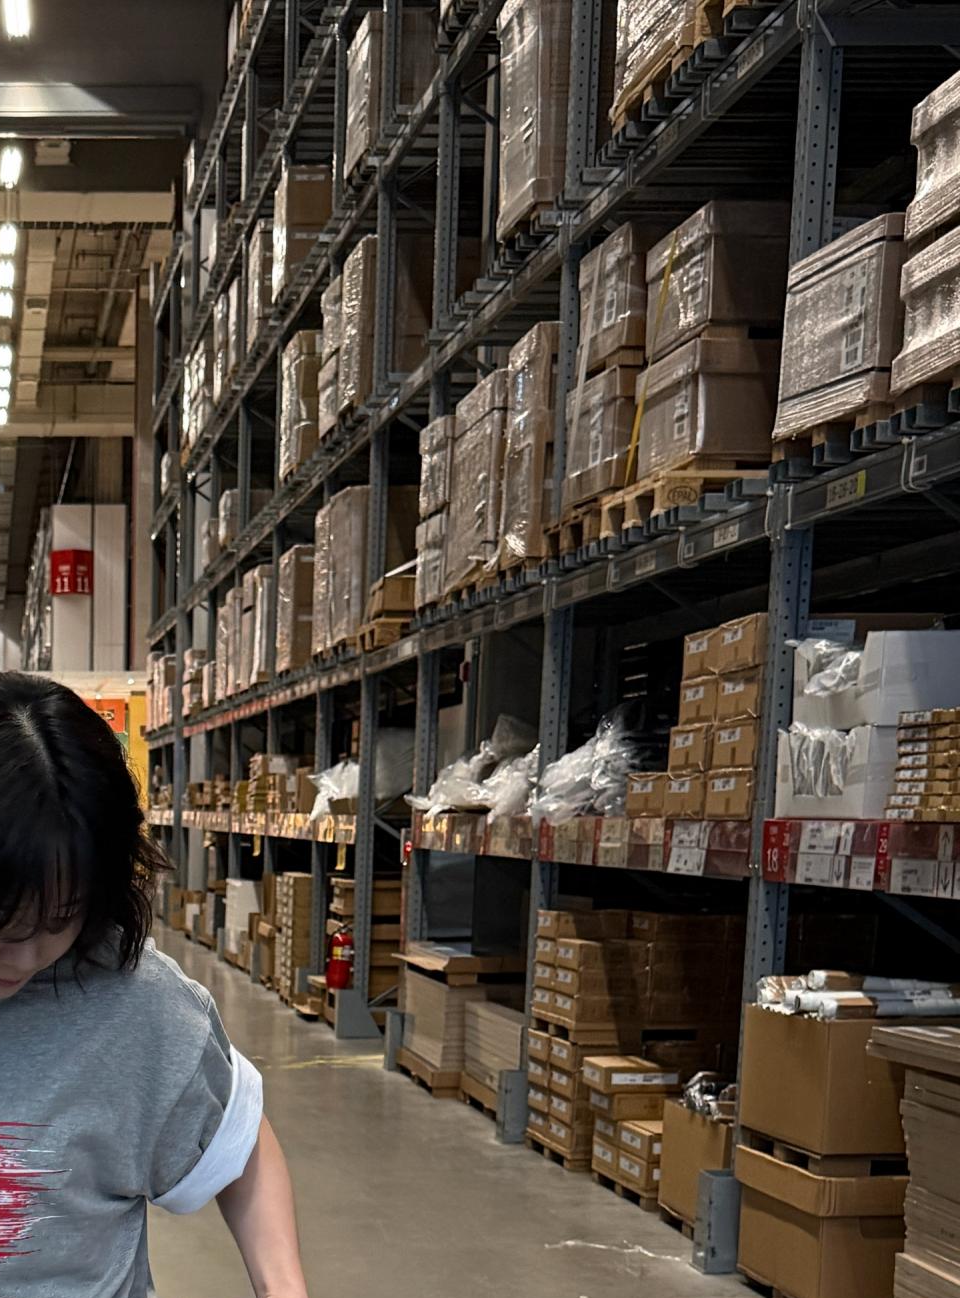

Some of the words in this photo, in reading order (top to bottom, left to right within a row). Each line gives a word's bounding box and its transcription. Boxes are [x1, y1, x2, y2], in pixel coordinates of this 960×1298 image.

[56, 577, 70, 593] 11
[77, 577, 89, 593] 11
[766, 848, 779, 873] 18
